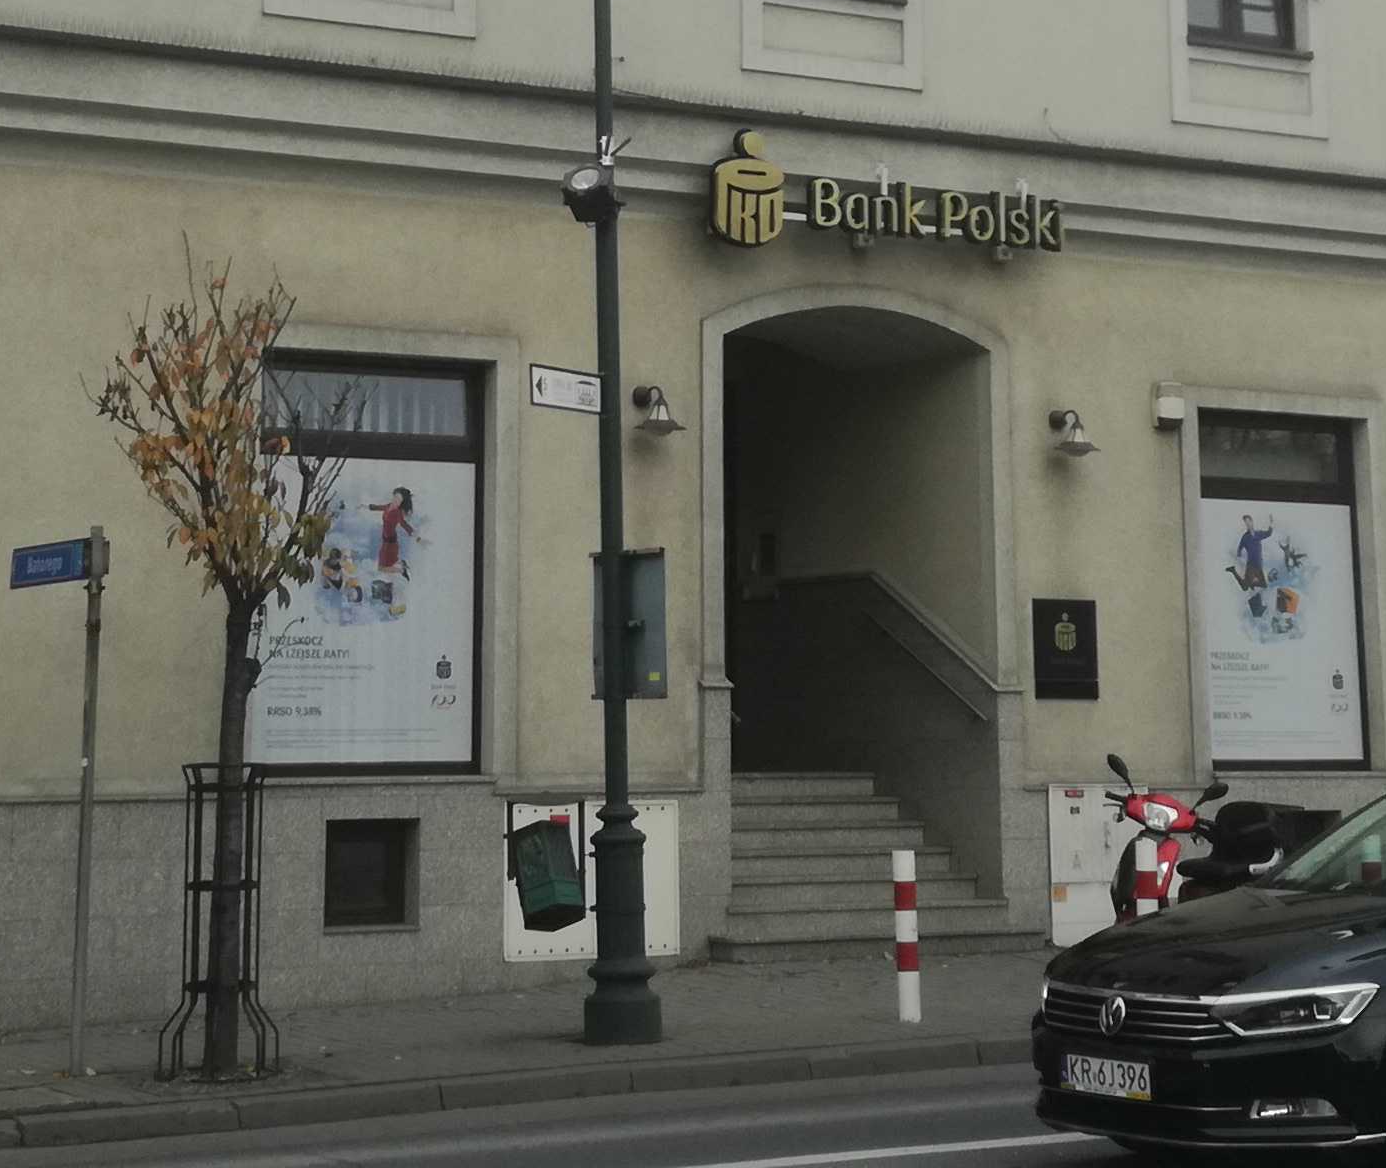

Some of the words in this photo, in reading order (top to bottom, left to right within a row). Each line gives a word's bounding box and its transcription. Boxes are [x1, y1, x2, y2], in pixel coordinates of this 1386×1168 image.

[812, 179, 927, 238] Bank
[1069, 1055, 1093, 1085] KR
[1097, 1060, 1147, 1091] 6J396
